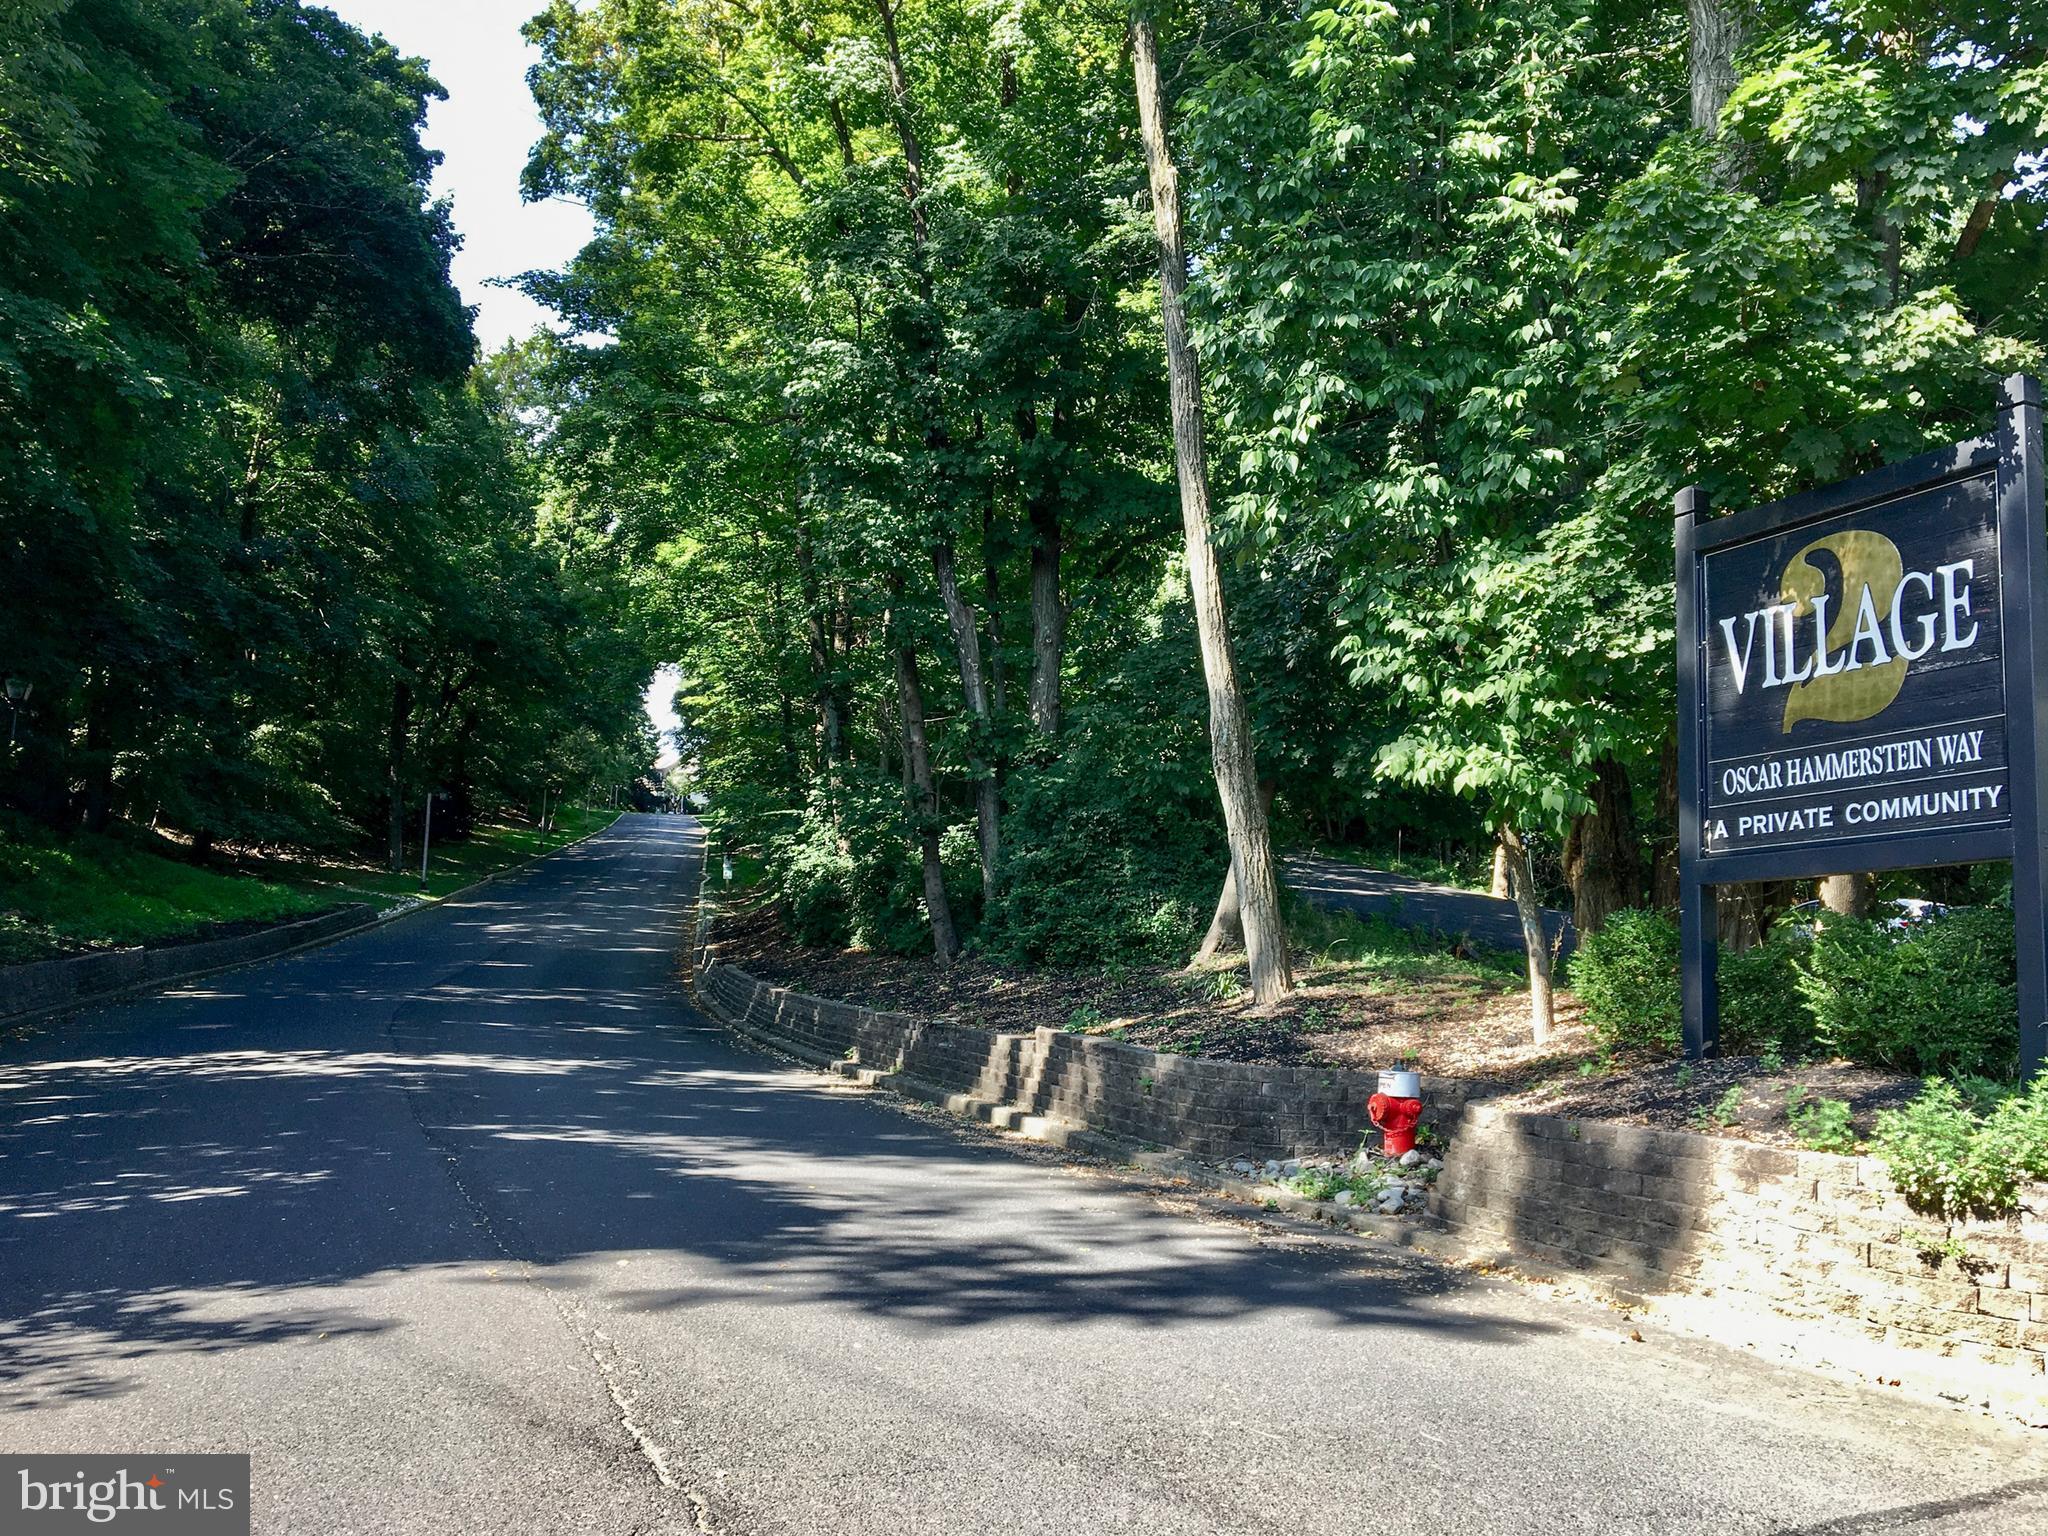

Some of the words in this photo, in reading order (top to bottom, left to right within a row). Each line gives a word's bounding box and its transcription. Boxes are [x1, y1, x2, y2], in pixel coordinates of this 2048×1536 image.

[1719, 558, 1979, 695] VILLAGE
[1780, 530, 1909, 734] 2
[1713, 819, 1729, 840] A
[1739, 805, 1834, 837] PRIVATE
[1845, 785, 2003, 825] COMMUNITY
[1722, 761, 1782, 796] OSCAR
[1786, 737, 1932, 786] HAMMERSTEIN
[1936, 729, 1984, 766] WAY
